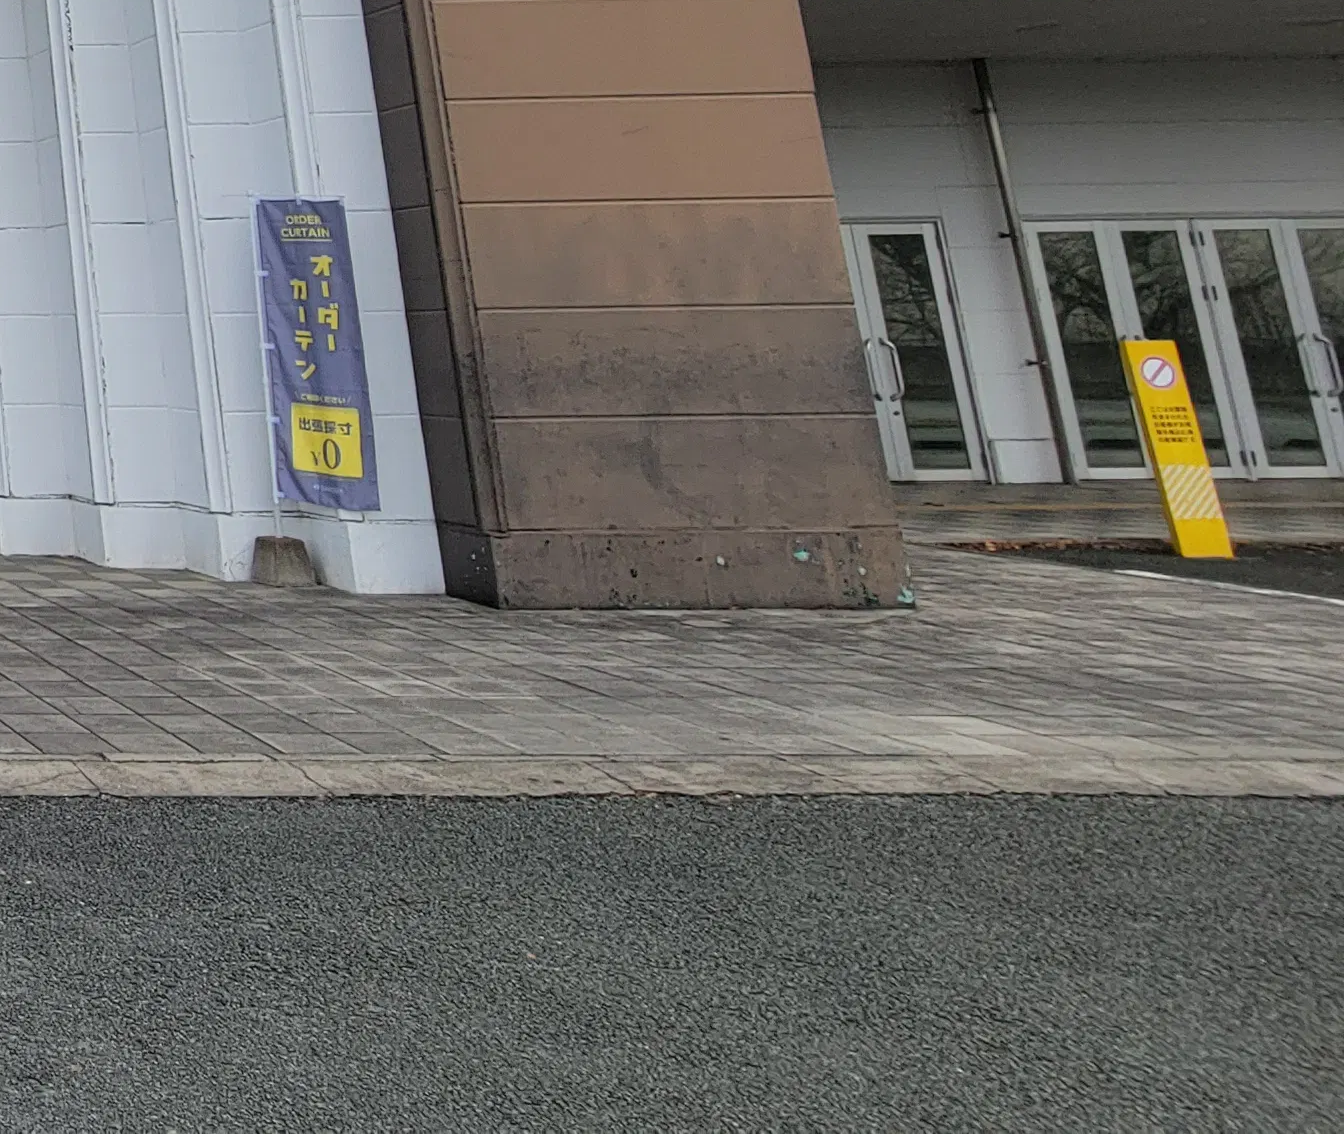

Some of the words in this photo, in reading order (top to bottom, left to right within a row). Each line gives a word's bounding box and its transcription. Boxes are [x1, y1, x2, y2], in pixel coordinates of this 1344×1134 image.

[280, 227, 330, 238] CURTAIN
[290, 278, 317, 380] カーテン
[310, 255, 339, 352] オーダー
